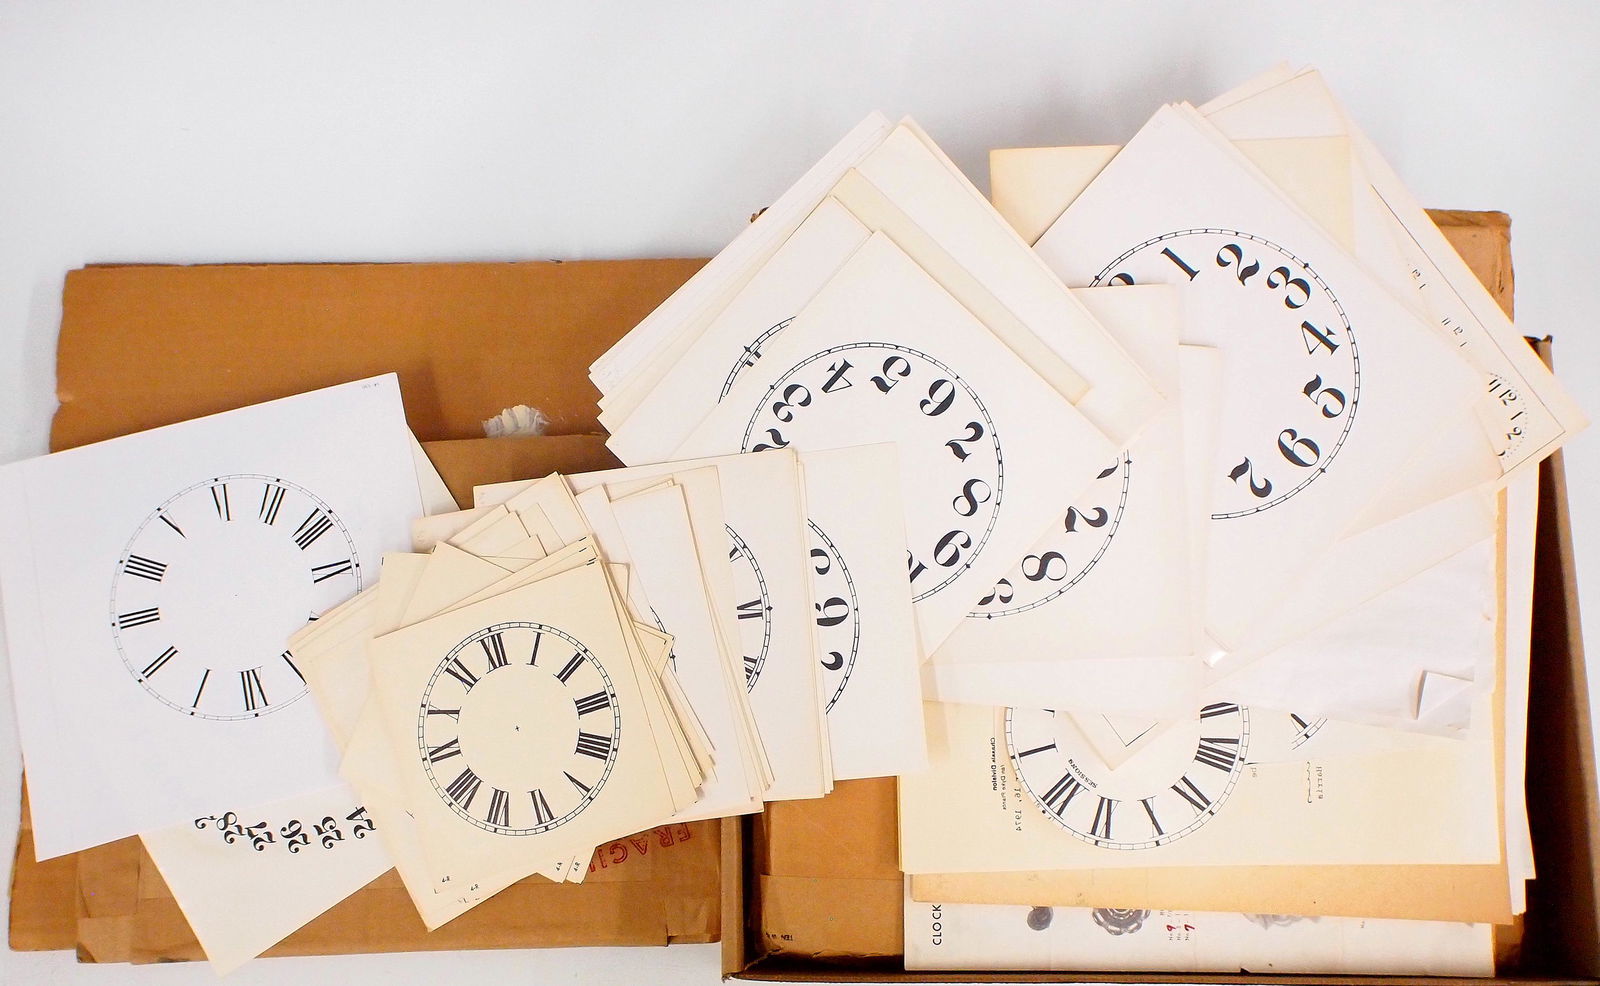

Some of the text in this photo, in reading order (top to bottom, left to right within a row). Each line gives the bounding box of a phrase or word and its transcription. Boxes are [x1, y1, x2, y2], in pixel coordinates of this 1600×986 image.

[1160, 247, 1200, 282] 1
[1216, 243, 1260, 286] 2
[1266, 266, 1311, 310] 3
[1301, 320, 1340, 356] 4
[821, 358, 854, 394] 4
[870, 356, 911, 395] 5
[772, 383, 812, 423] 3
[1302, 374, 1346, 419] 5
[1499, 389, 1517, 406] 12
[1277, 428, 1320, 467] 6
[1507, 426, 1522, 440] 2
[1227, 456, 1272, 498] 7
[210, 483, 233, 521] VI
[953, 478, 991, 517] 8
[1022, 551, 1068, 581] 8
[476, 631, 512, 674] XII
[553, 649, 588, 687] II
[443, 655, 481, 695] XI
[573, 686, 611, 720] III
[563, 771, 594, 800] V
[1068, 759, 1098, 788] SESSIONS
[346, 806, 376, 839] 24
[483, 787, 512, 827] VII
[527, 788, 558, 826] VI
[216, 811, 246, 845] 28
[245, 822, 276, 851] 27
[280, 820, 311, 854] 26
[313, 816, 345, 849] 25
[932, 904, 942, 946] CLOCK
